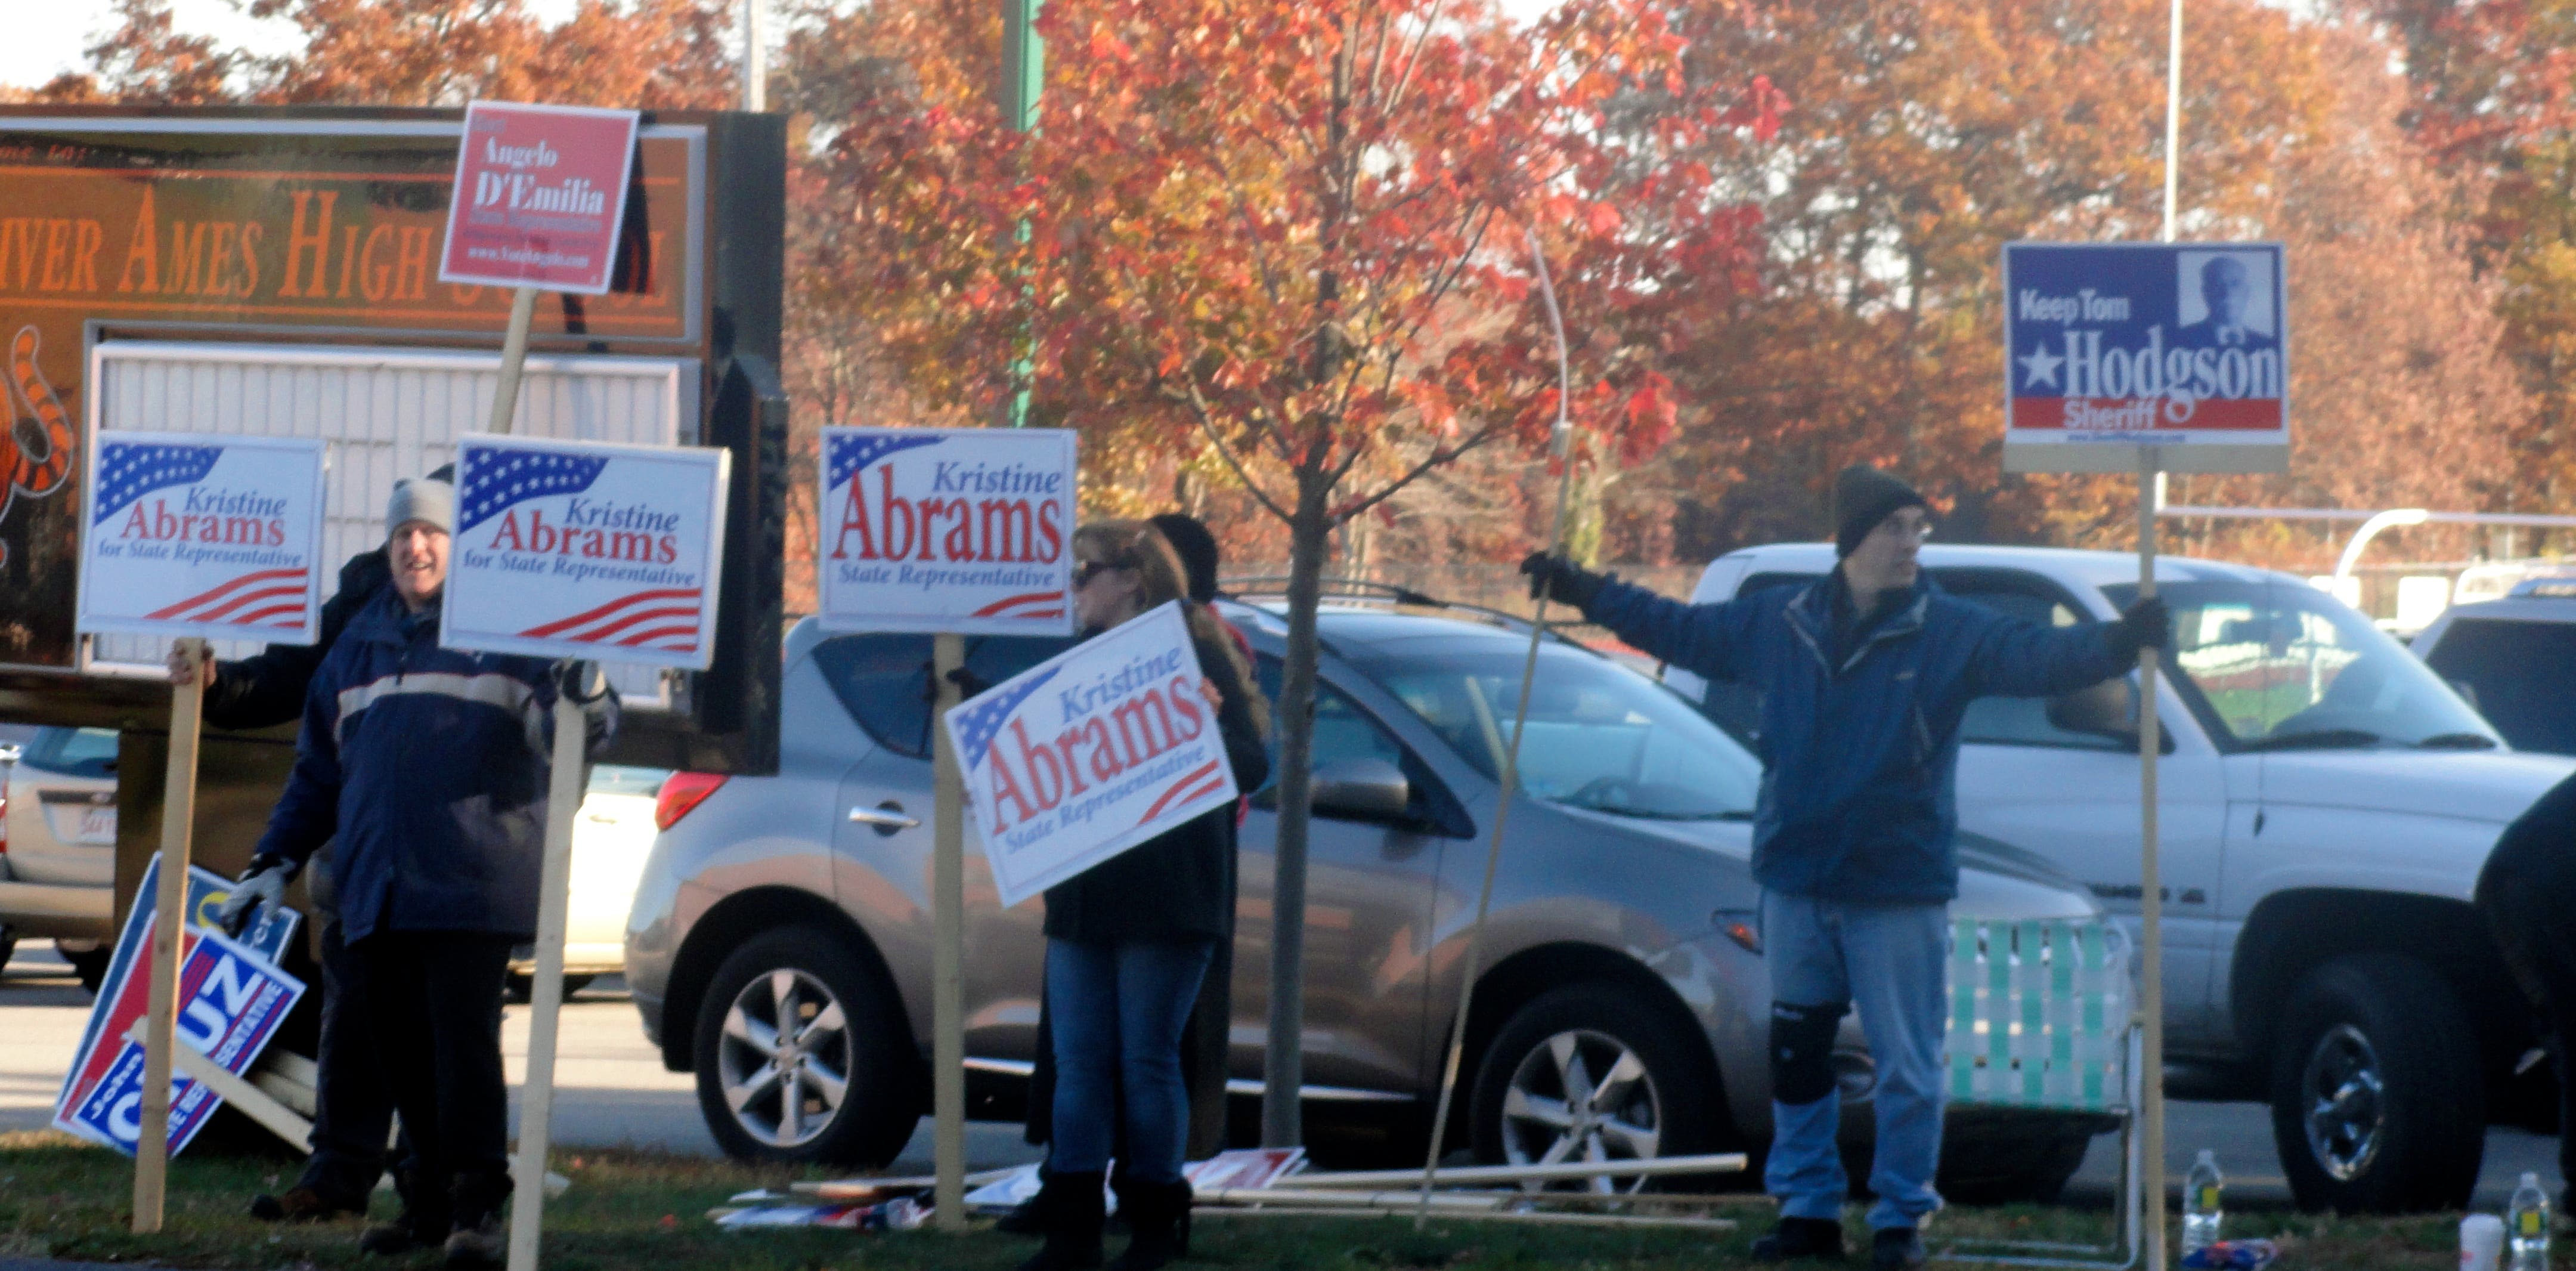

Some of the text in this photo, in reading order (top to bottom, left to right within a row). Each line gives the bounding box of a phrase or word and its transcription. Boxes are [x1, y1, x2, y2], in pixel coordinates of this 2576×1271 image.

[483, 136, 558, 169] Angelo
[474, 171, 605, 214] D'Emilia
[2018, 287, 2131, 326] Keep Tom
[2062, 324, 2278, 423] Hodgson
[2063, 399, 2157, 430] Sheriff
[931, 461, 1063, 494] Kristine
[120, 499, 286, 547] Abrams
[184, 487, 287, 517] Kristine
[565, 498, 680, 533] Kristine
[831, 462, 1063, 565] Abrams
[97, 537, 303, 567] for State Representative
[489, 508, 677, 565] Abrams
[462, 549, 696, 587] for State Representative
[838, 562, 1055, 591] State Representative
[1059, 646, 1183, 724] Kristine
[987, 675, 1203, 836] Abrams
[1004, 744, 1206, 855] State Representative
[109, 954, 265, 1141] CUZ
[91, 1053, 145, 1120] John
